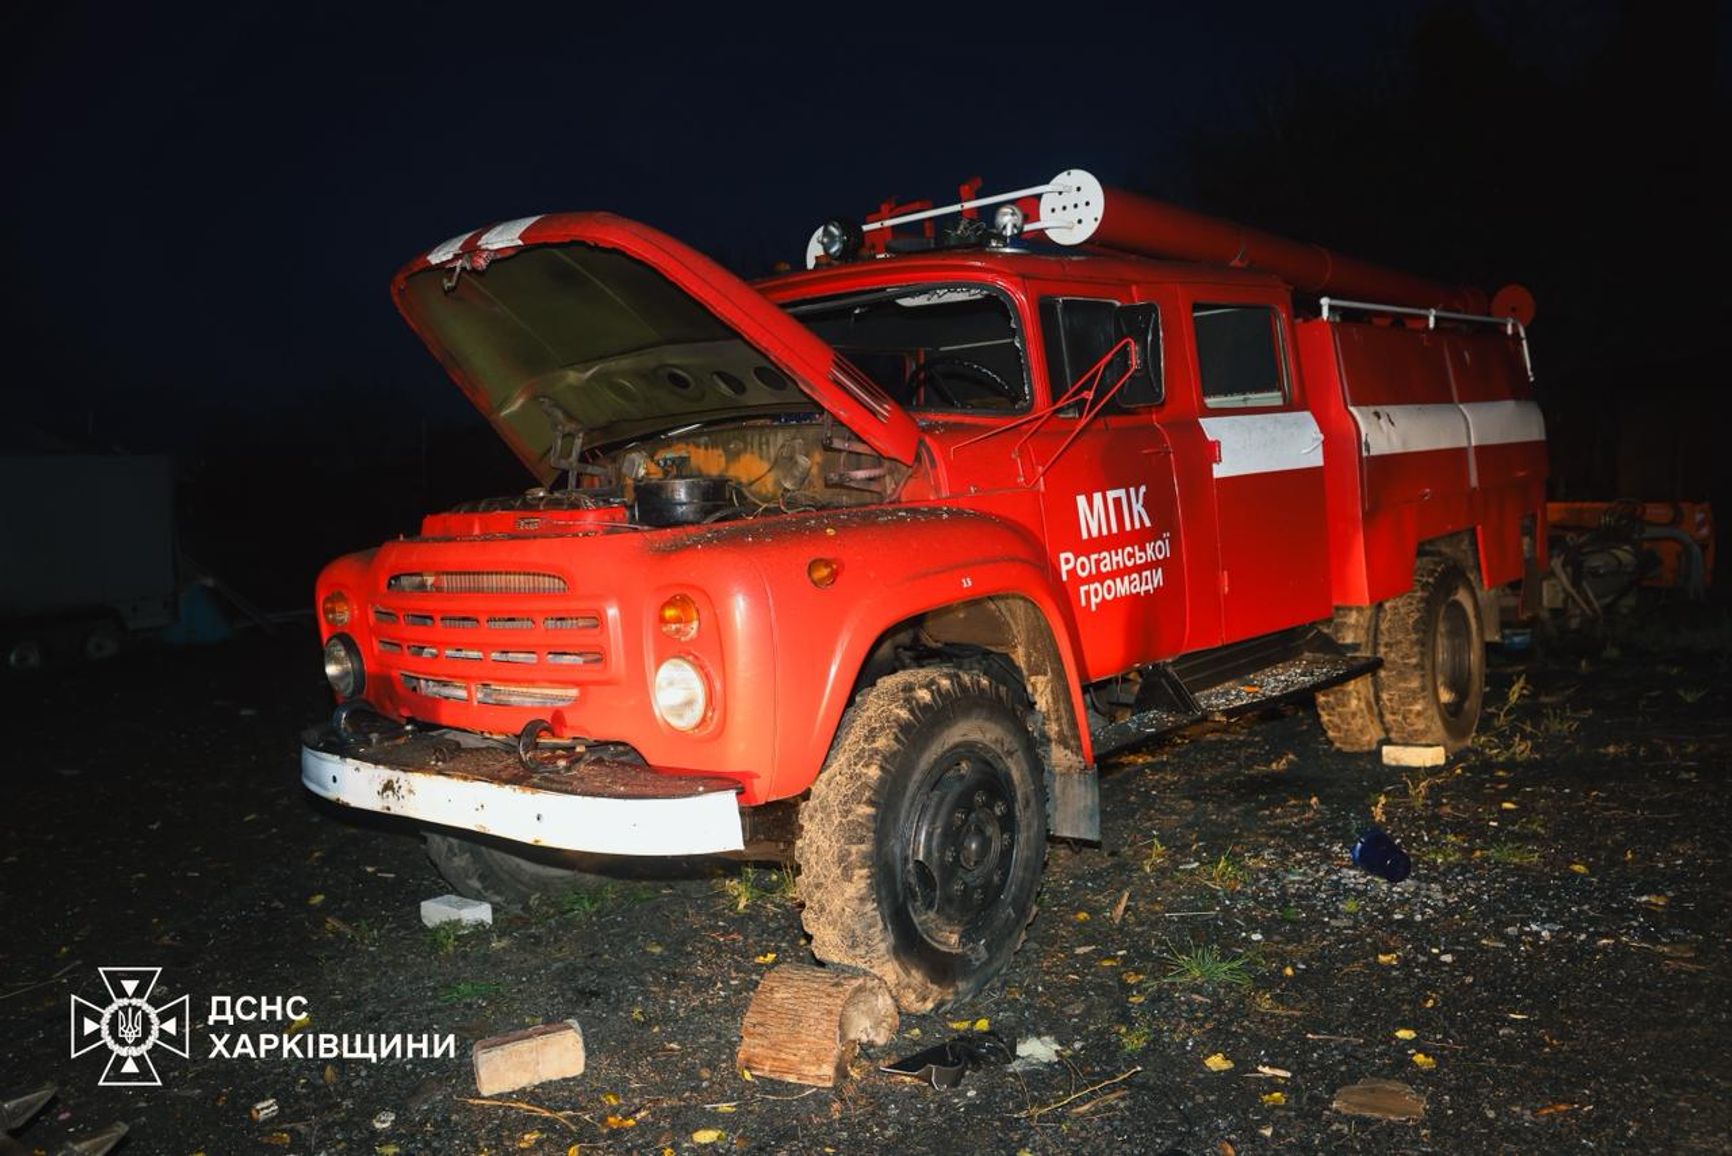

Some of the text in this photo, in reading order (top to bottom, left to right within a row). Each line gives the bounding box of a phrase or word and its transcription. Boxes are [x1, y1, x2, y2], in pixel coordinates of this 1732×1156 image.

[1076, 485, 1151, 540] МПК
[1059, 532, 1170, 582] Роганської
[1079, 567, 1163, 611] громади
